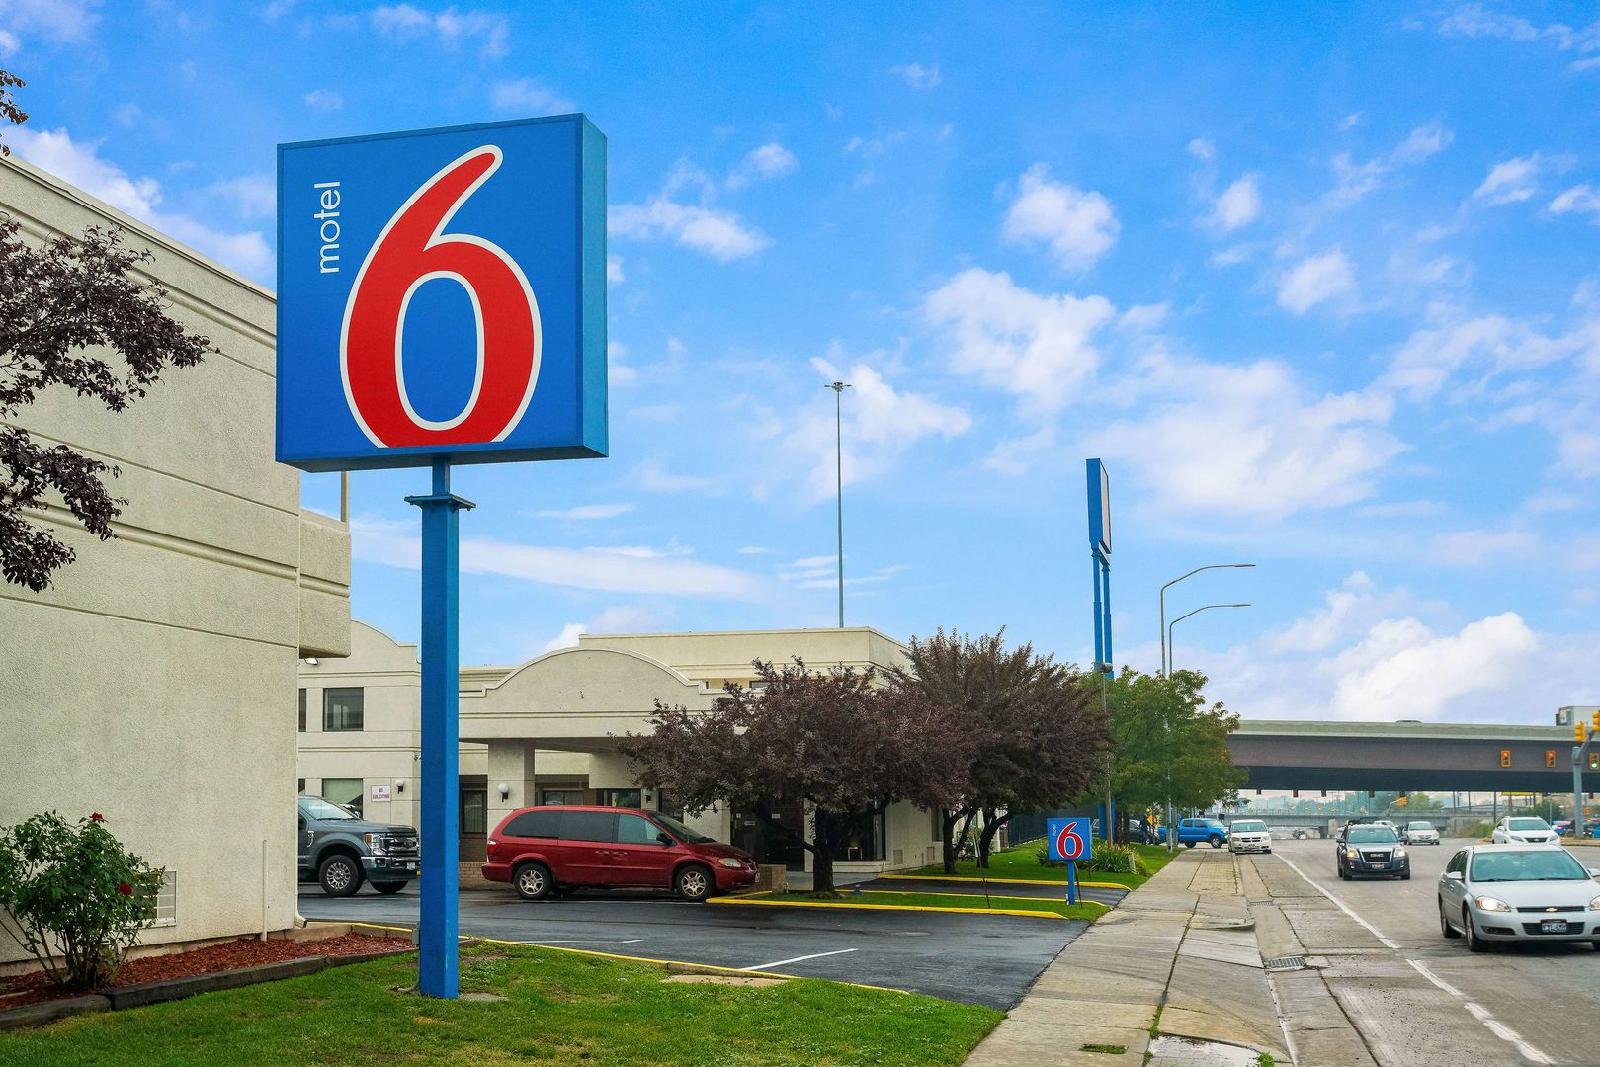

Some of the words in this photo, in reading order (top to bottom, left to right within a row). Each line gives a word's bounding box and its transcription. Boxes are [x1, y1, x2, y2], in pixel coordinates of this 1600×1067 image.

[313, 181, 341, 274] motel
[339, 144, 543, 449] 6
[1056, 821, 1084, 859] 6
